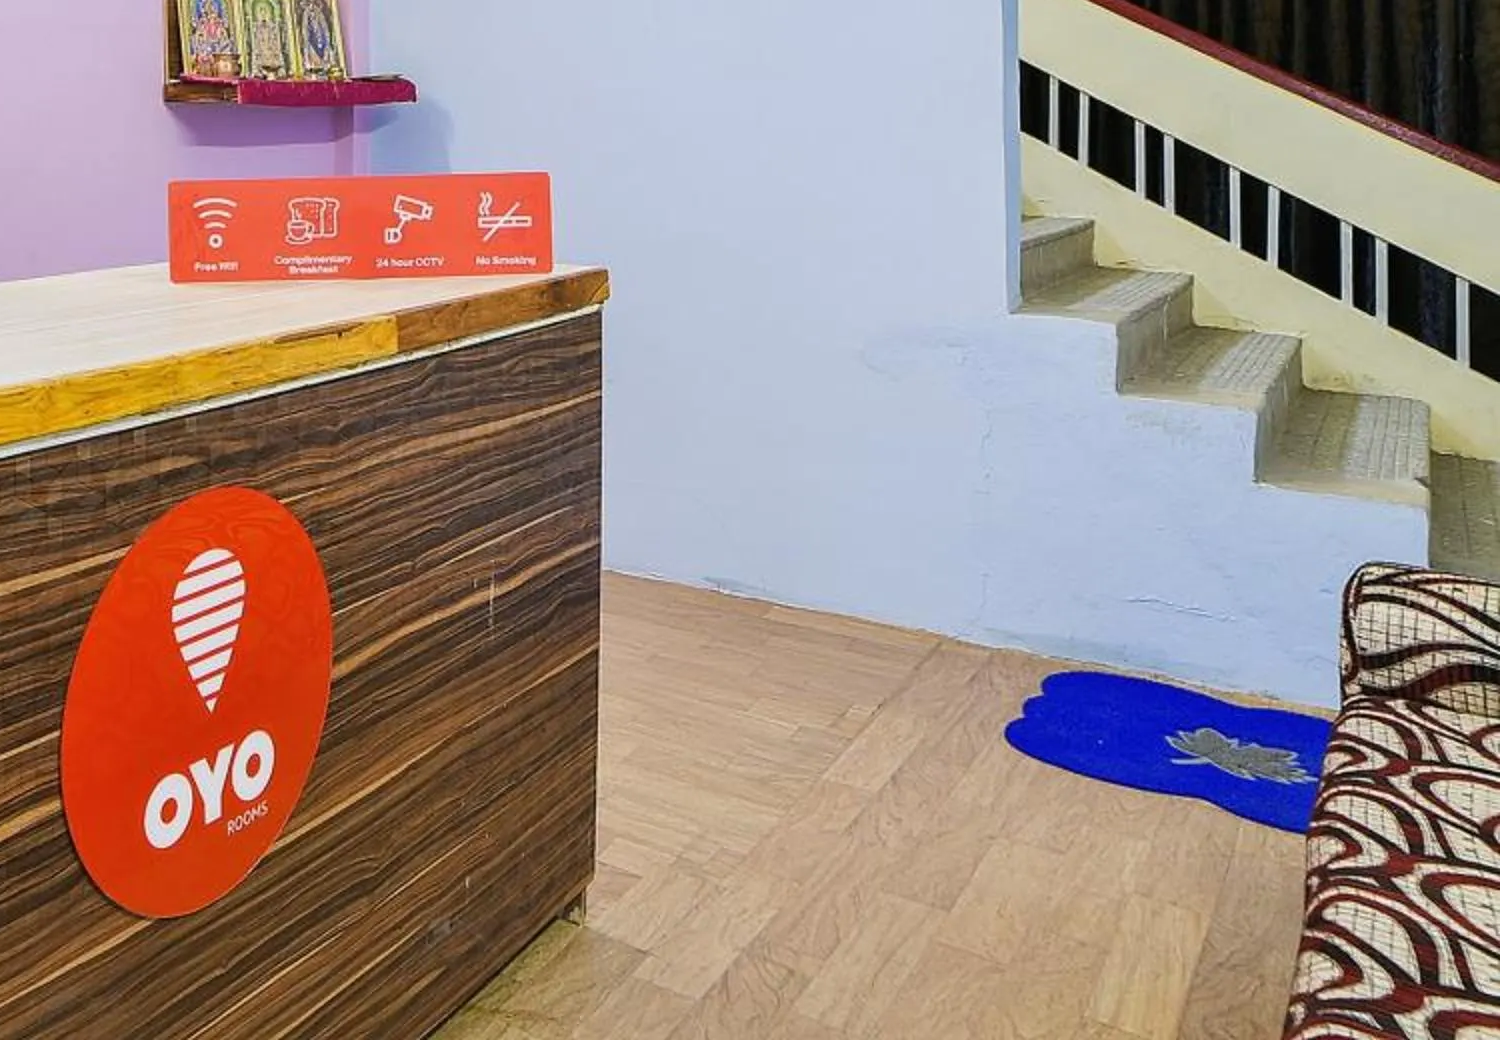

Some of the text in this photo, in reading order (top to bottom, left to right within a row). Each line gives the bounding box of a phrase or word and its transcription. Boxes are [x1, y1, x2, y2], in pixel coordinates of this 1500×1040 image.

[194, 261, 218, 272] Free
[274, 255, 353, 267] Complimentary
[375, 255, 445, 268] 24 hour CCTV
[475, 255, 537, 268] No Smoking
[288, 265, 340, 275] Breakfast
[143, 729, 275, 849] OYO
[227, 800, 268, 835] ROOMS
